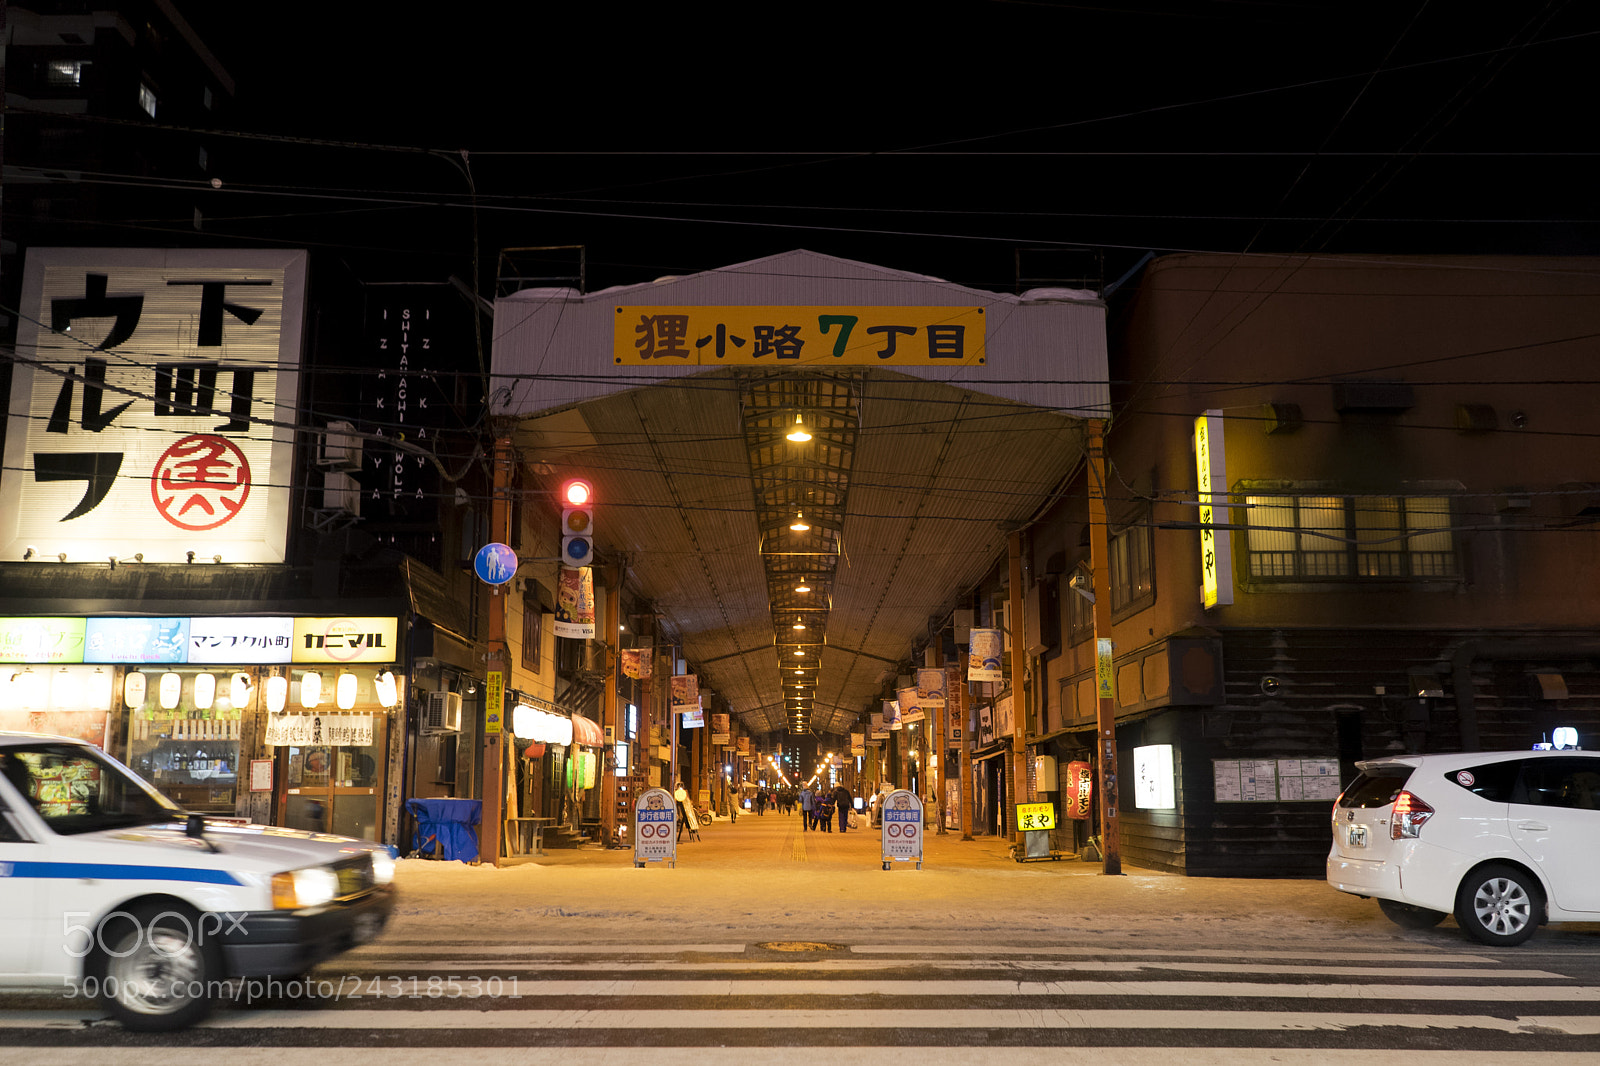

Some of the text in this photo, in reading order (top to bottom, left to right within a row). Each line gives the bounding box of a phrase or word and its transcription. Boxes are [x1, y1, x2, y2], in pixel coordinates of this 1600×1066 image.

[635, 314, 965, 360] 狸小路7丁目
[155, 280, 273, 432] 下町
[34, 273, 145, 522] ウルフ
[303, 632, 387, 649] カニマル
[639, 811, 672, 821] 歩行者専用
[886, 811, 919, 821] 歩行者専用
[1023, 813, 1050, 829] 炭や
